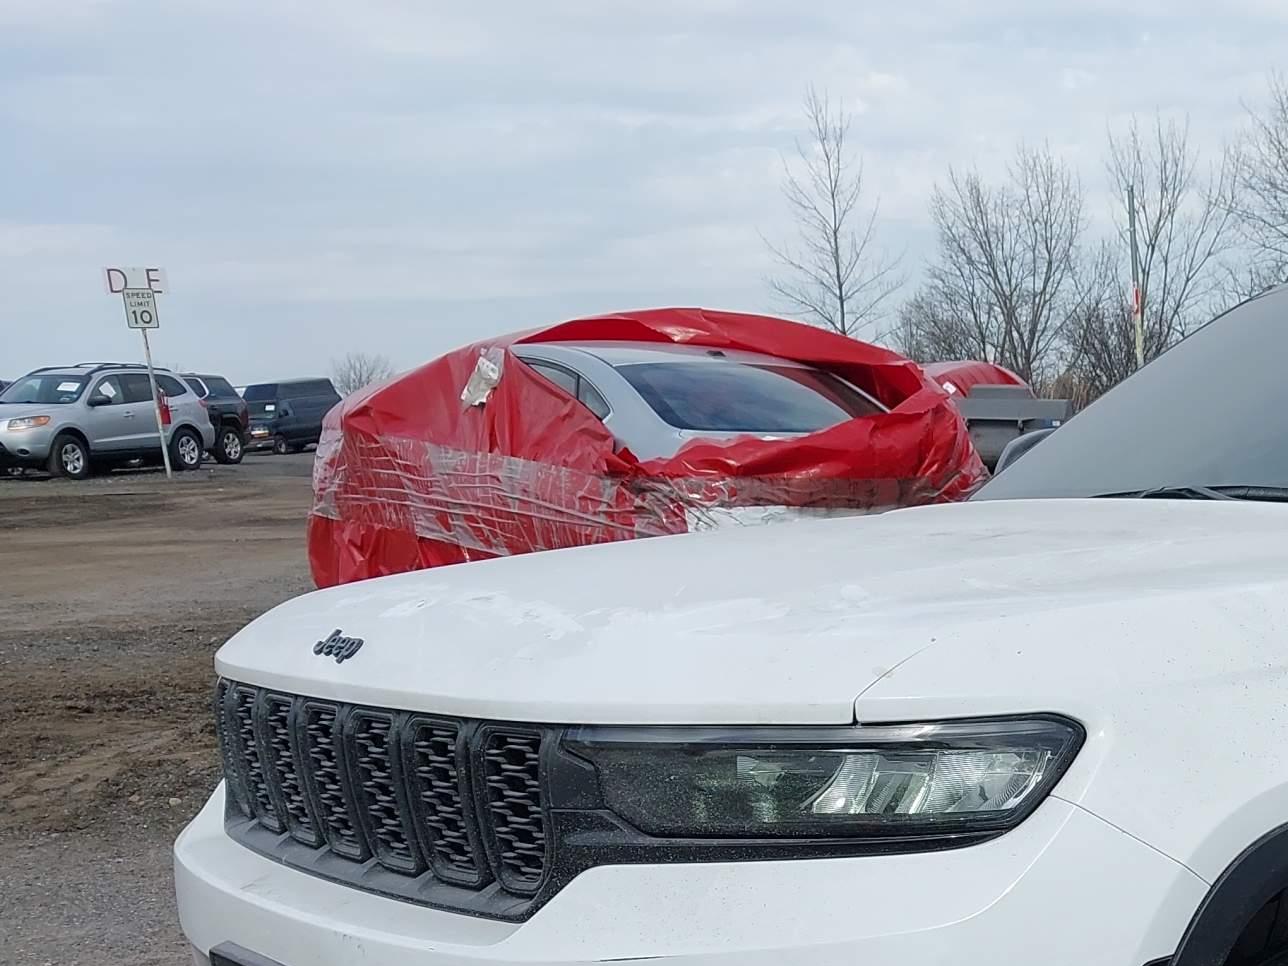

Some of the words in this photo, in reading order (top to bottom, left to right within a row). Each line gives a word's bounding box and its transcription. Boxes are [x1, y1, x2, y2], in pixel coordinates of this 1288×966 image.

[106, 268, 127, 293] D
[145, 268, 162, 293] E
[131, 309, 152, 324] 10
[312, 628, 365, 665] Jeep
